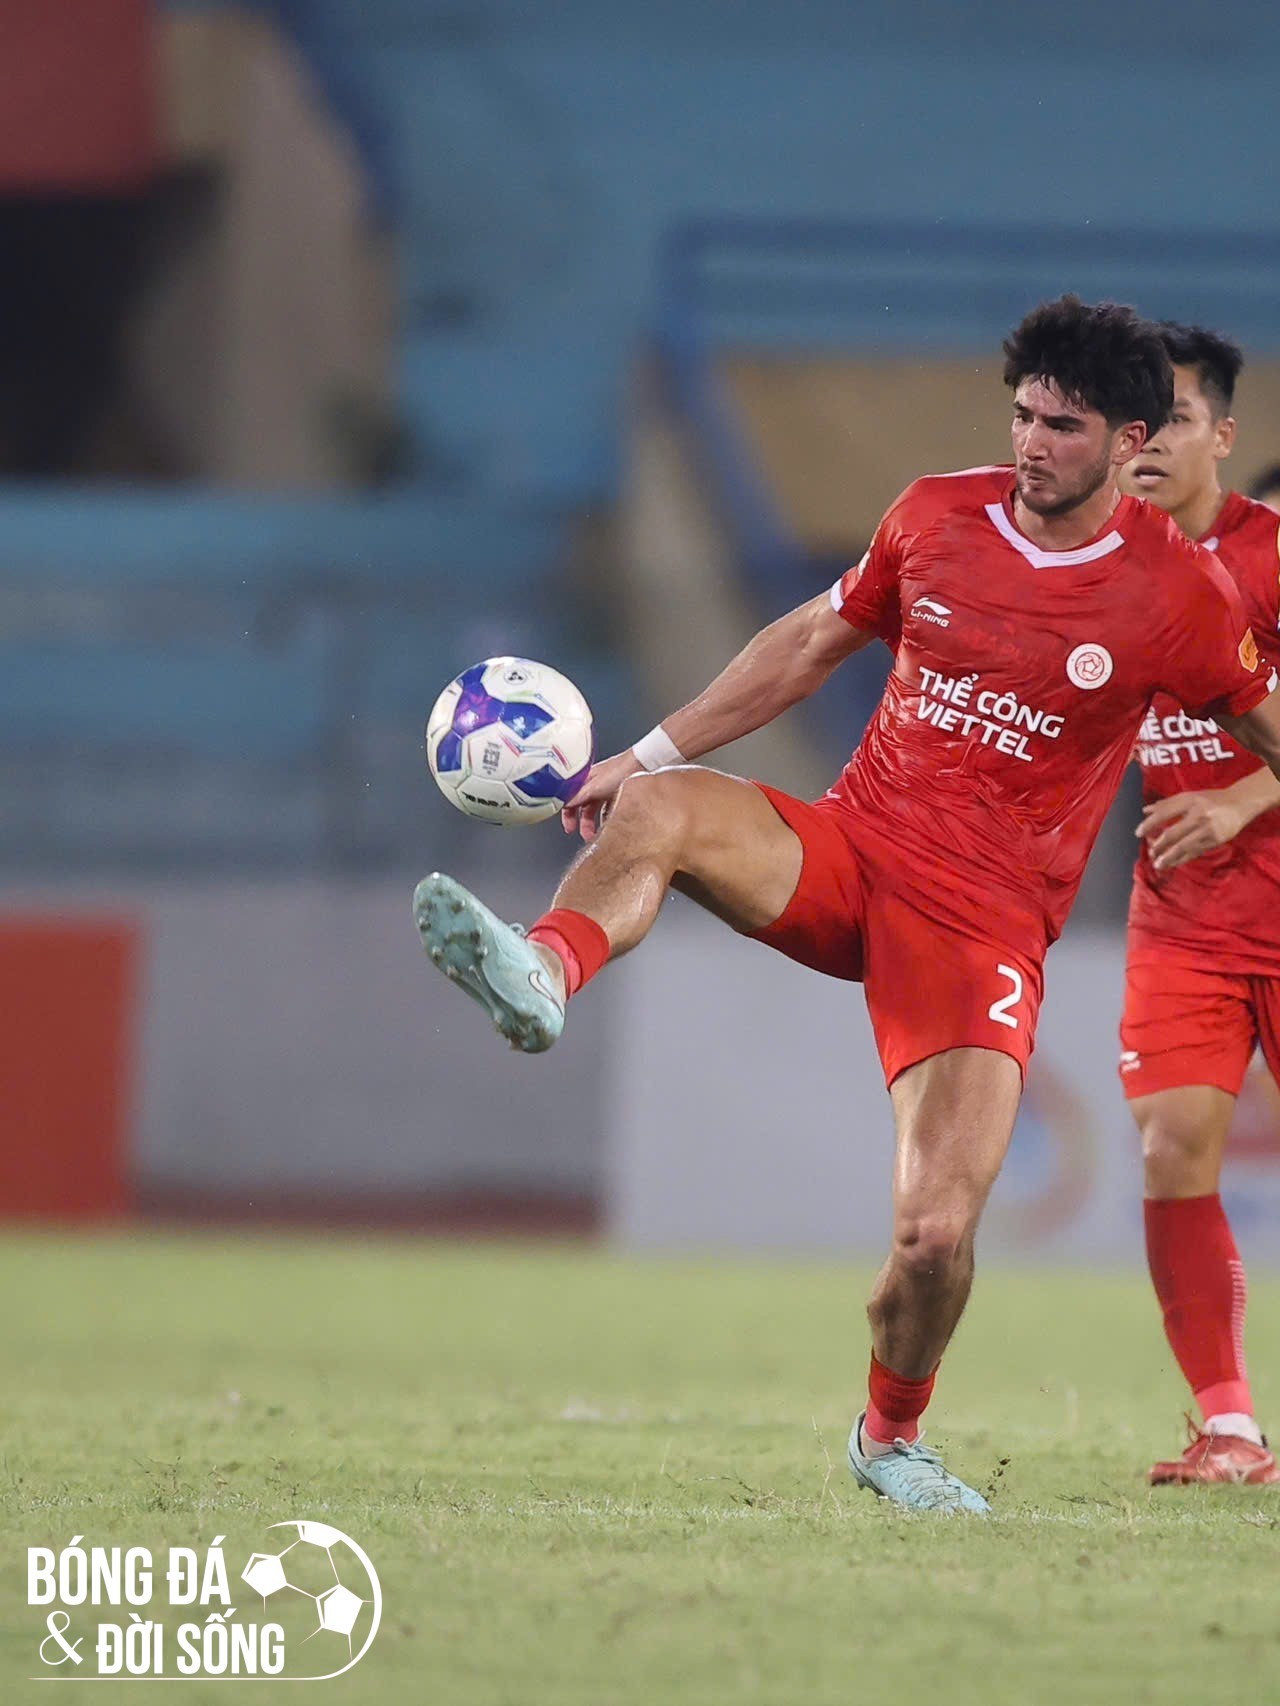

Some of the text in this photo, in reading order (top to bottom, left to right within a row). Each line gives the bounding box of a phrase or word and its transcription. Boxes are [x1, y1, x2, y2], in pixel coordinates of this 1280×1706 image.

[917, 695, 1033, 762] VIETTEL
[918, 666, 1066, 739] THỂ CÔNG
[988, 963, 1023, 1029] 2
